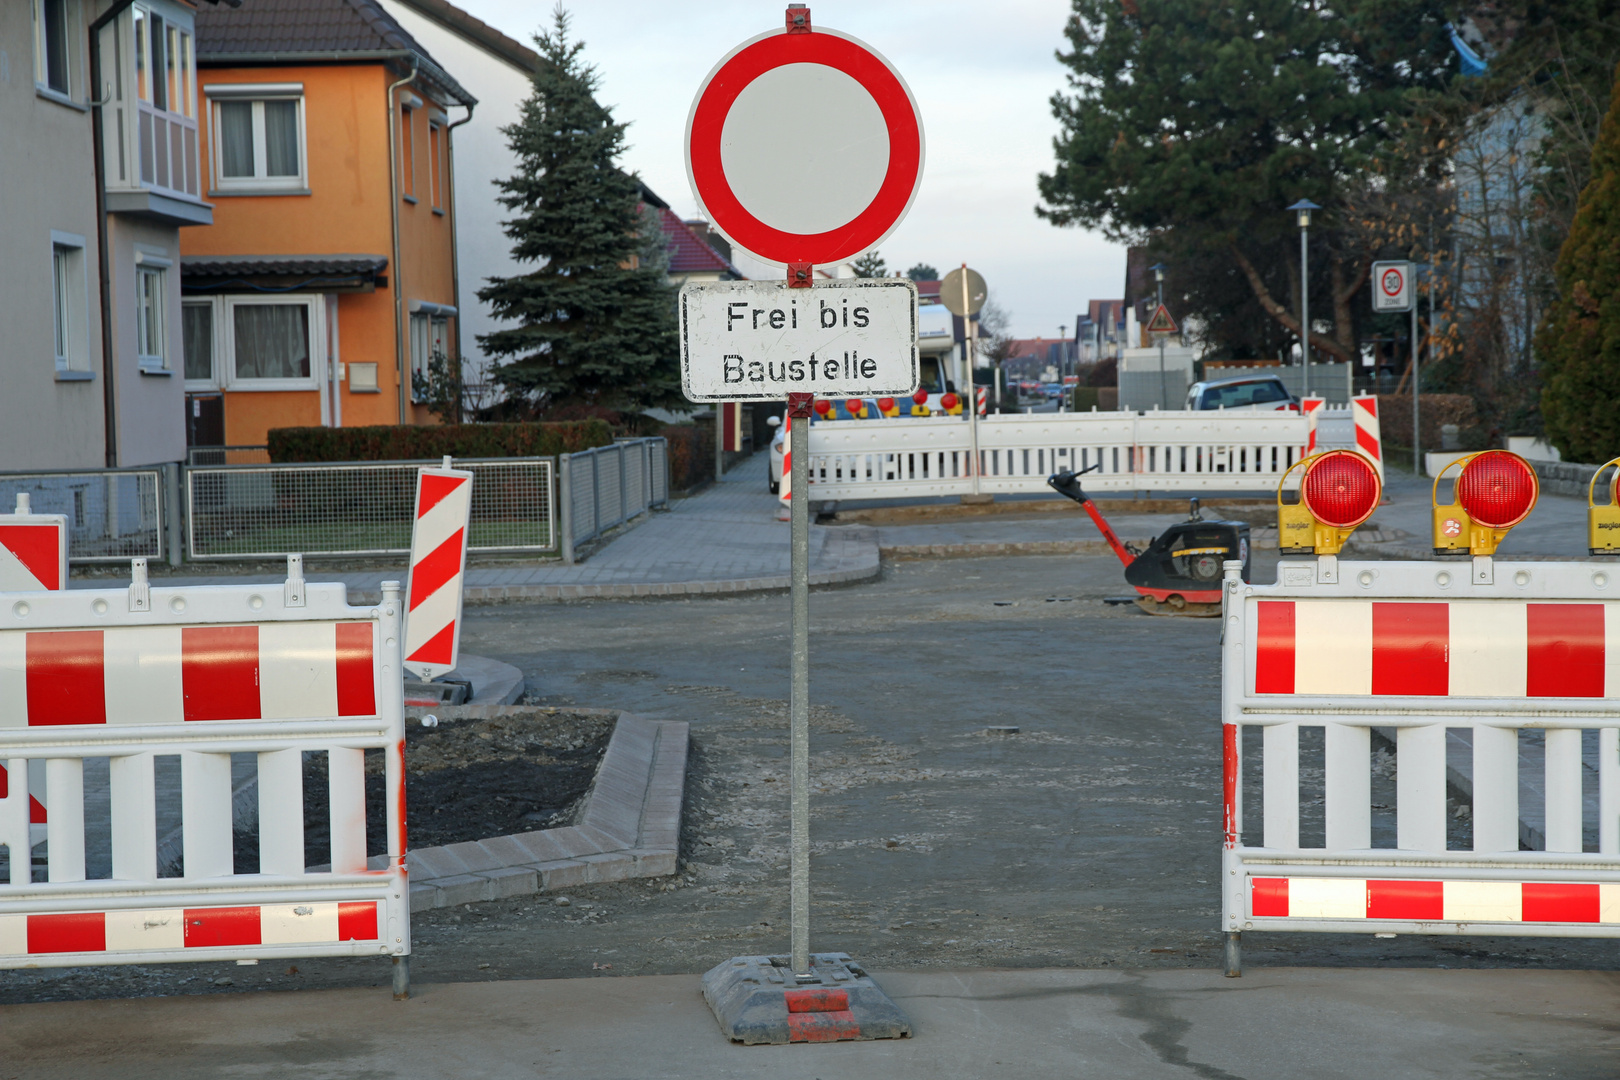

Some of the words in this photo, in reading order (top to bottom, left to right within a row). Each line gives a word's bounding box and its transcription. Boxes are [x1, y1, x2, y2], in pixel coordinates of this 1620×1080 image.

[1386, 276, 1400, 289] 30
[727, 299, 797, 332] Frei
[819, 298, 870, 329] bis
[722, 350, 878, 384] Baustelle
